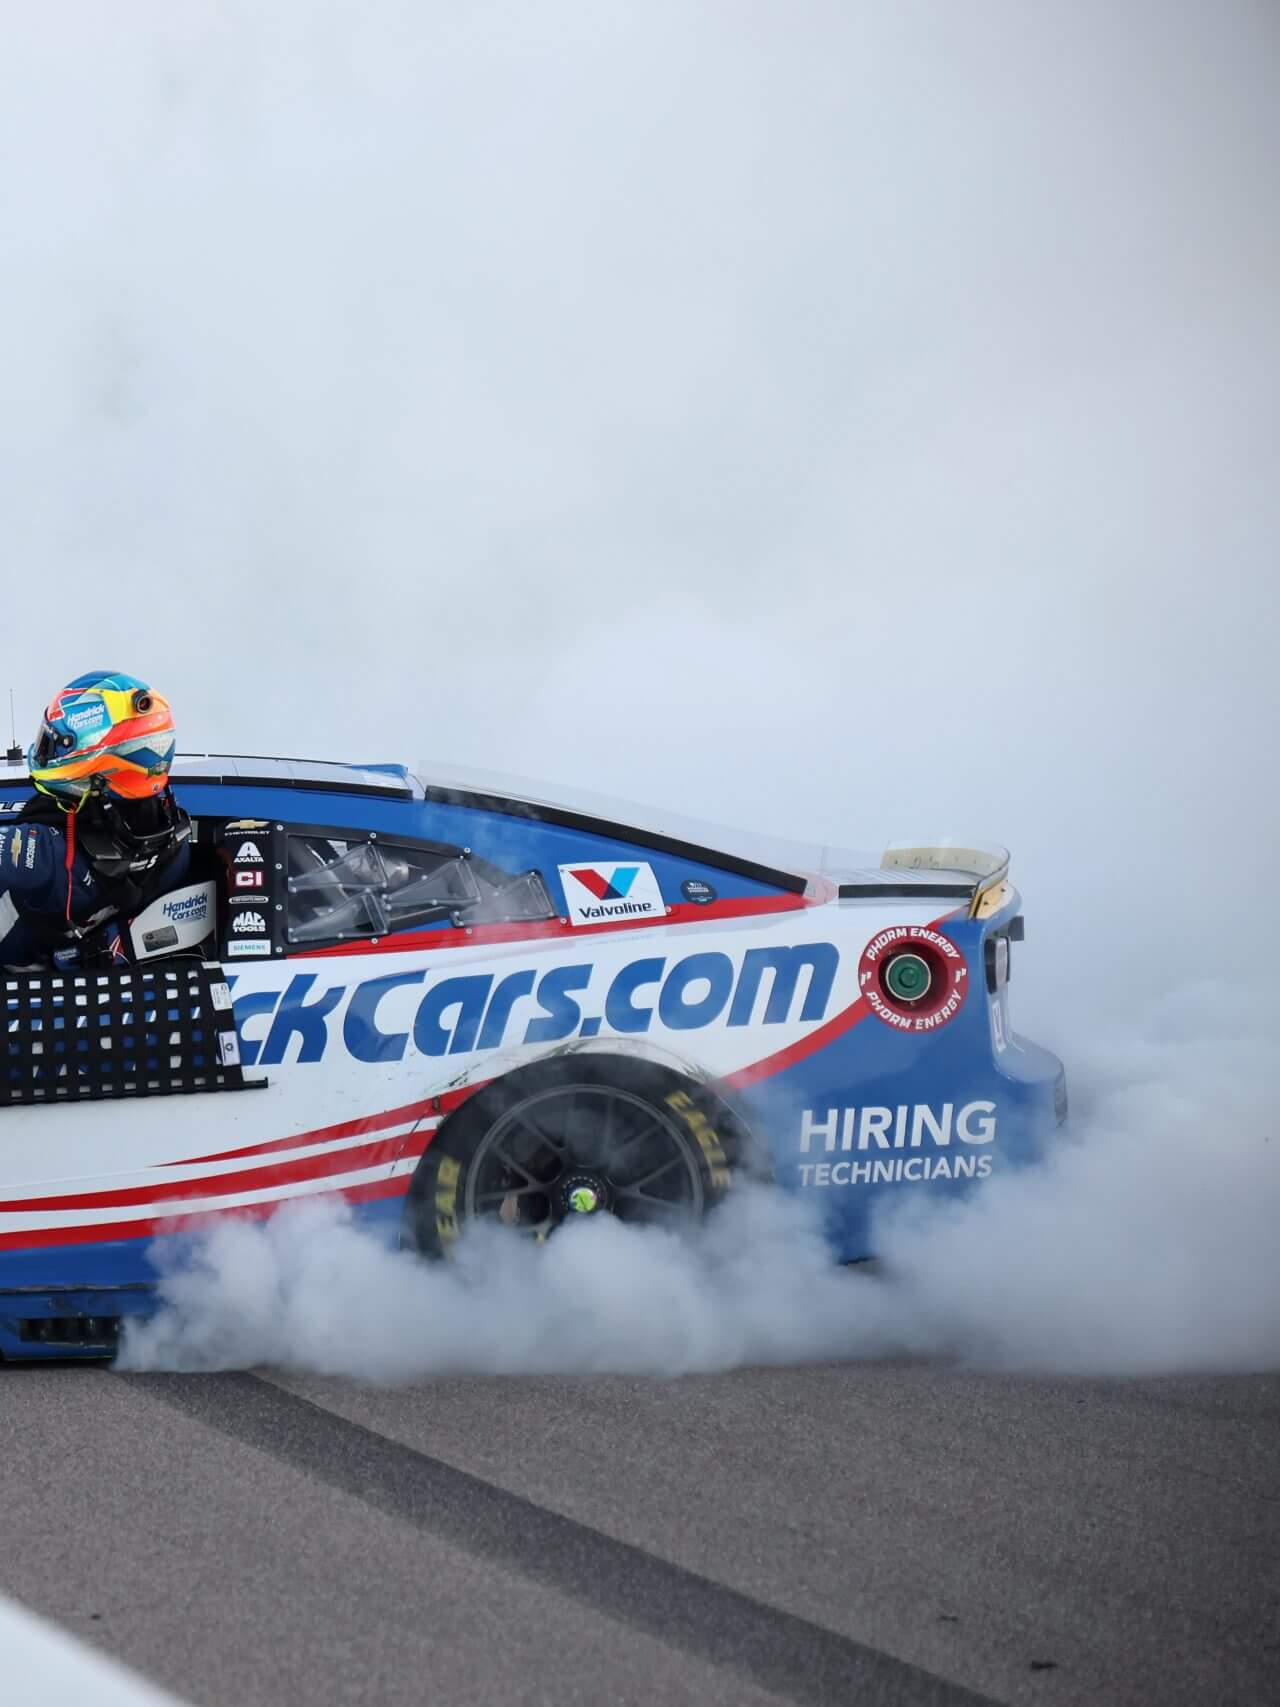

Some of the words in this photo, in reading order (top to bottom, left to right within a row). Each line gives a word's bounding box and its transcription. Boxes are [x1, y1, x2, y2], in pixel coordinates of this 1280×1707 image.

[162, 892, 209, 917] Hendrick
[171, 905, 207, 921] Cars.com
[579, 902, 652, 919] Valvoline
[232, 911, 266, 927] MAC
[910, 927, 961, 959] ENERGY
[914, 990, 962, 1030] ENERGY
[799, 1100, 997, 1153] HIRING
[798, 1155, 993, 1187] TECHNICIANS
